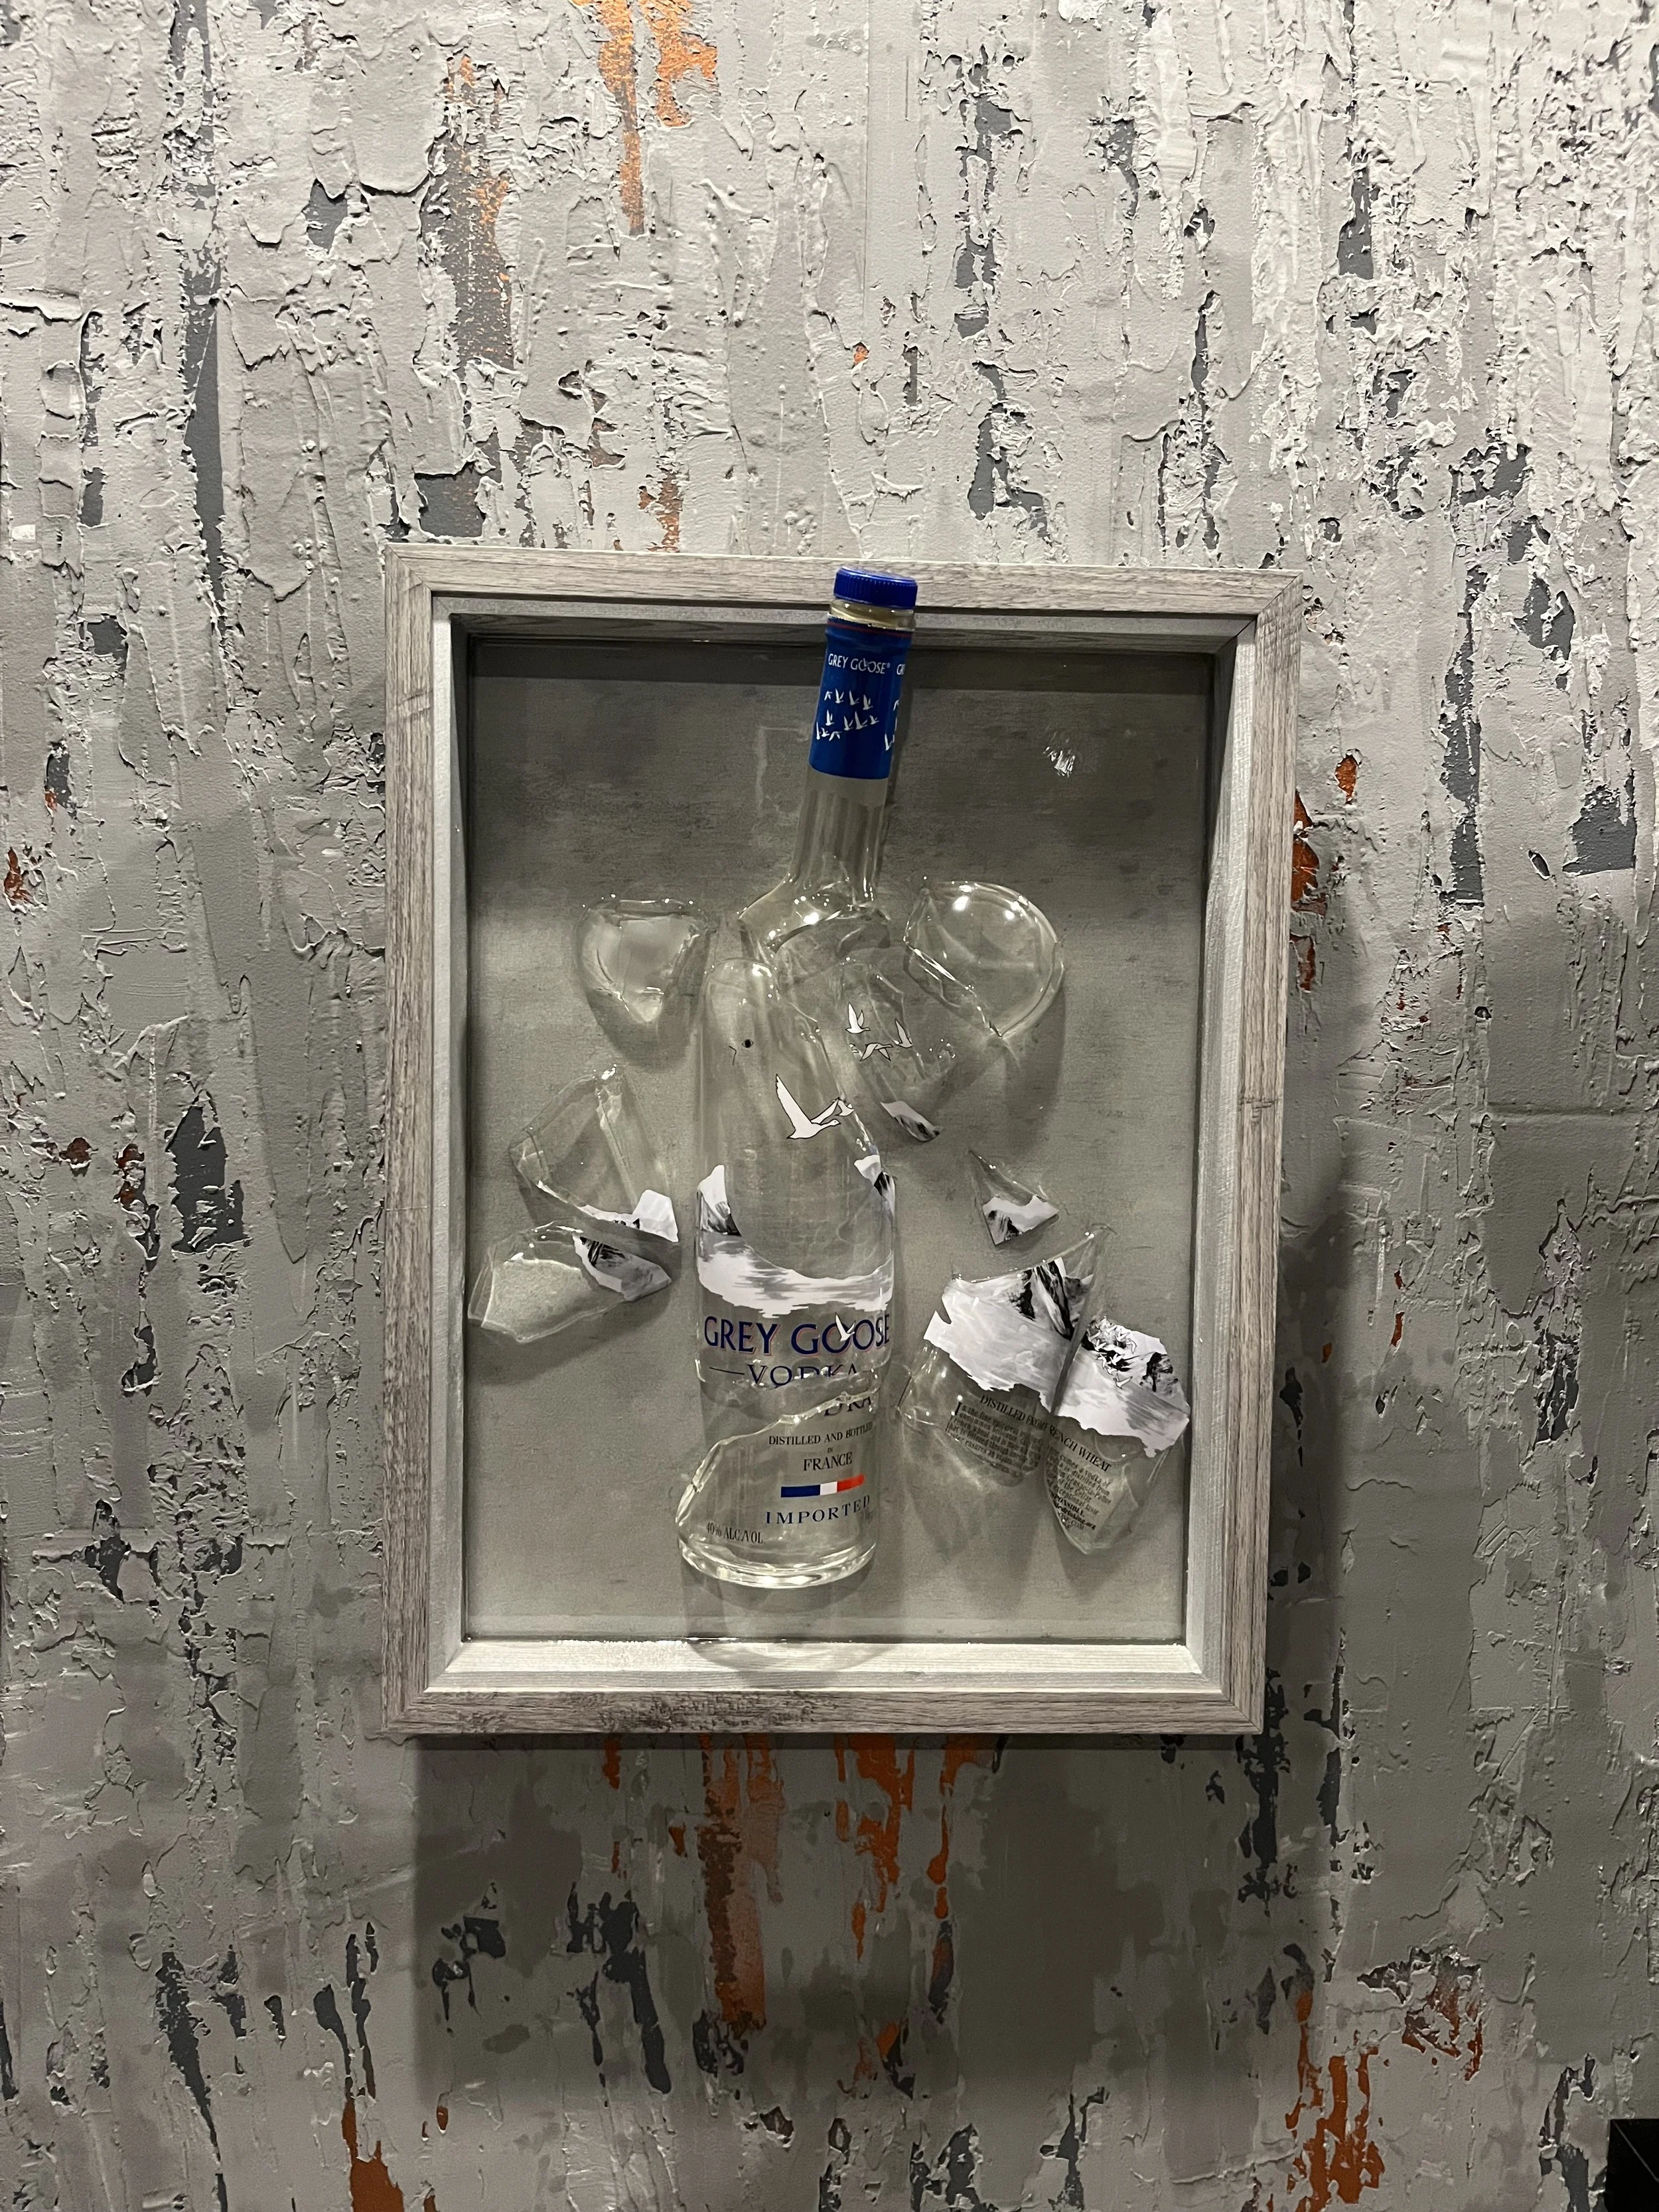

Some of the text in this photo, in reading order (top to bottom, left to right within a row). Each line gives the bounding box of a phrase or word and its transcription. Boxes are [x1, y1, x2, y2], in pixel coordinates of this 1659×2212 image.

[828, 653, 848, 668] GREY
[703, 1313, 890, 1355] GREY GOOSE
[979, 1394, 1026, 1422] DISTILLED
[768, 1435, 821, 1445] DISTILLED
[824, 1431, 843, 1443] AND
[1050, 1425, 1078, 1451] RENCH
[1078, 1447, 1112, 1471] WHEAT
[804, 1451, 853, 1471] FRANCE
[766, 1495, 870, 1524] IMPORTED
[706, 1521, 722, 1537] 40%
